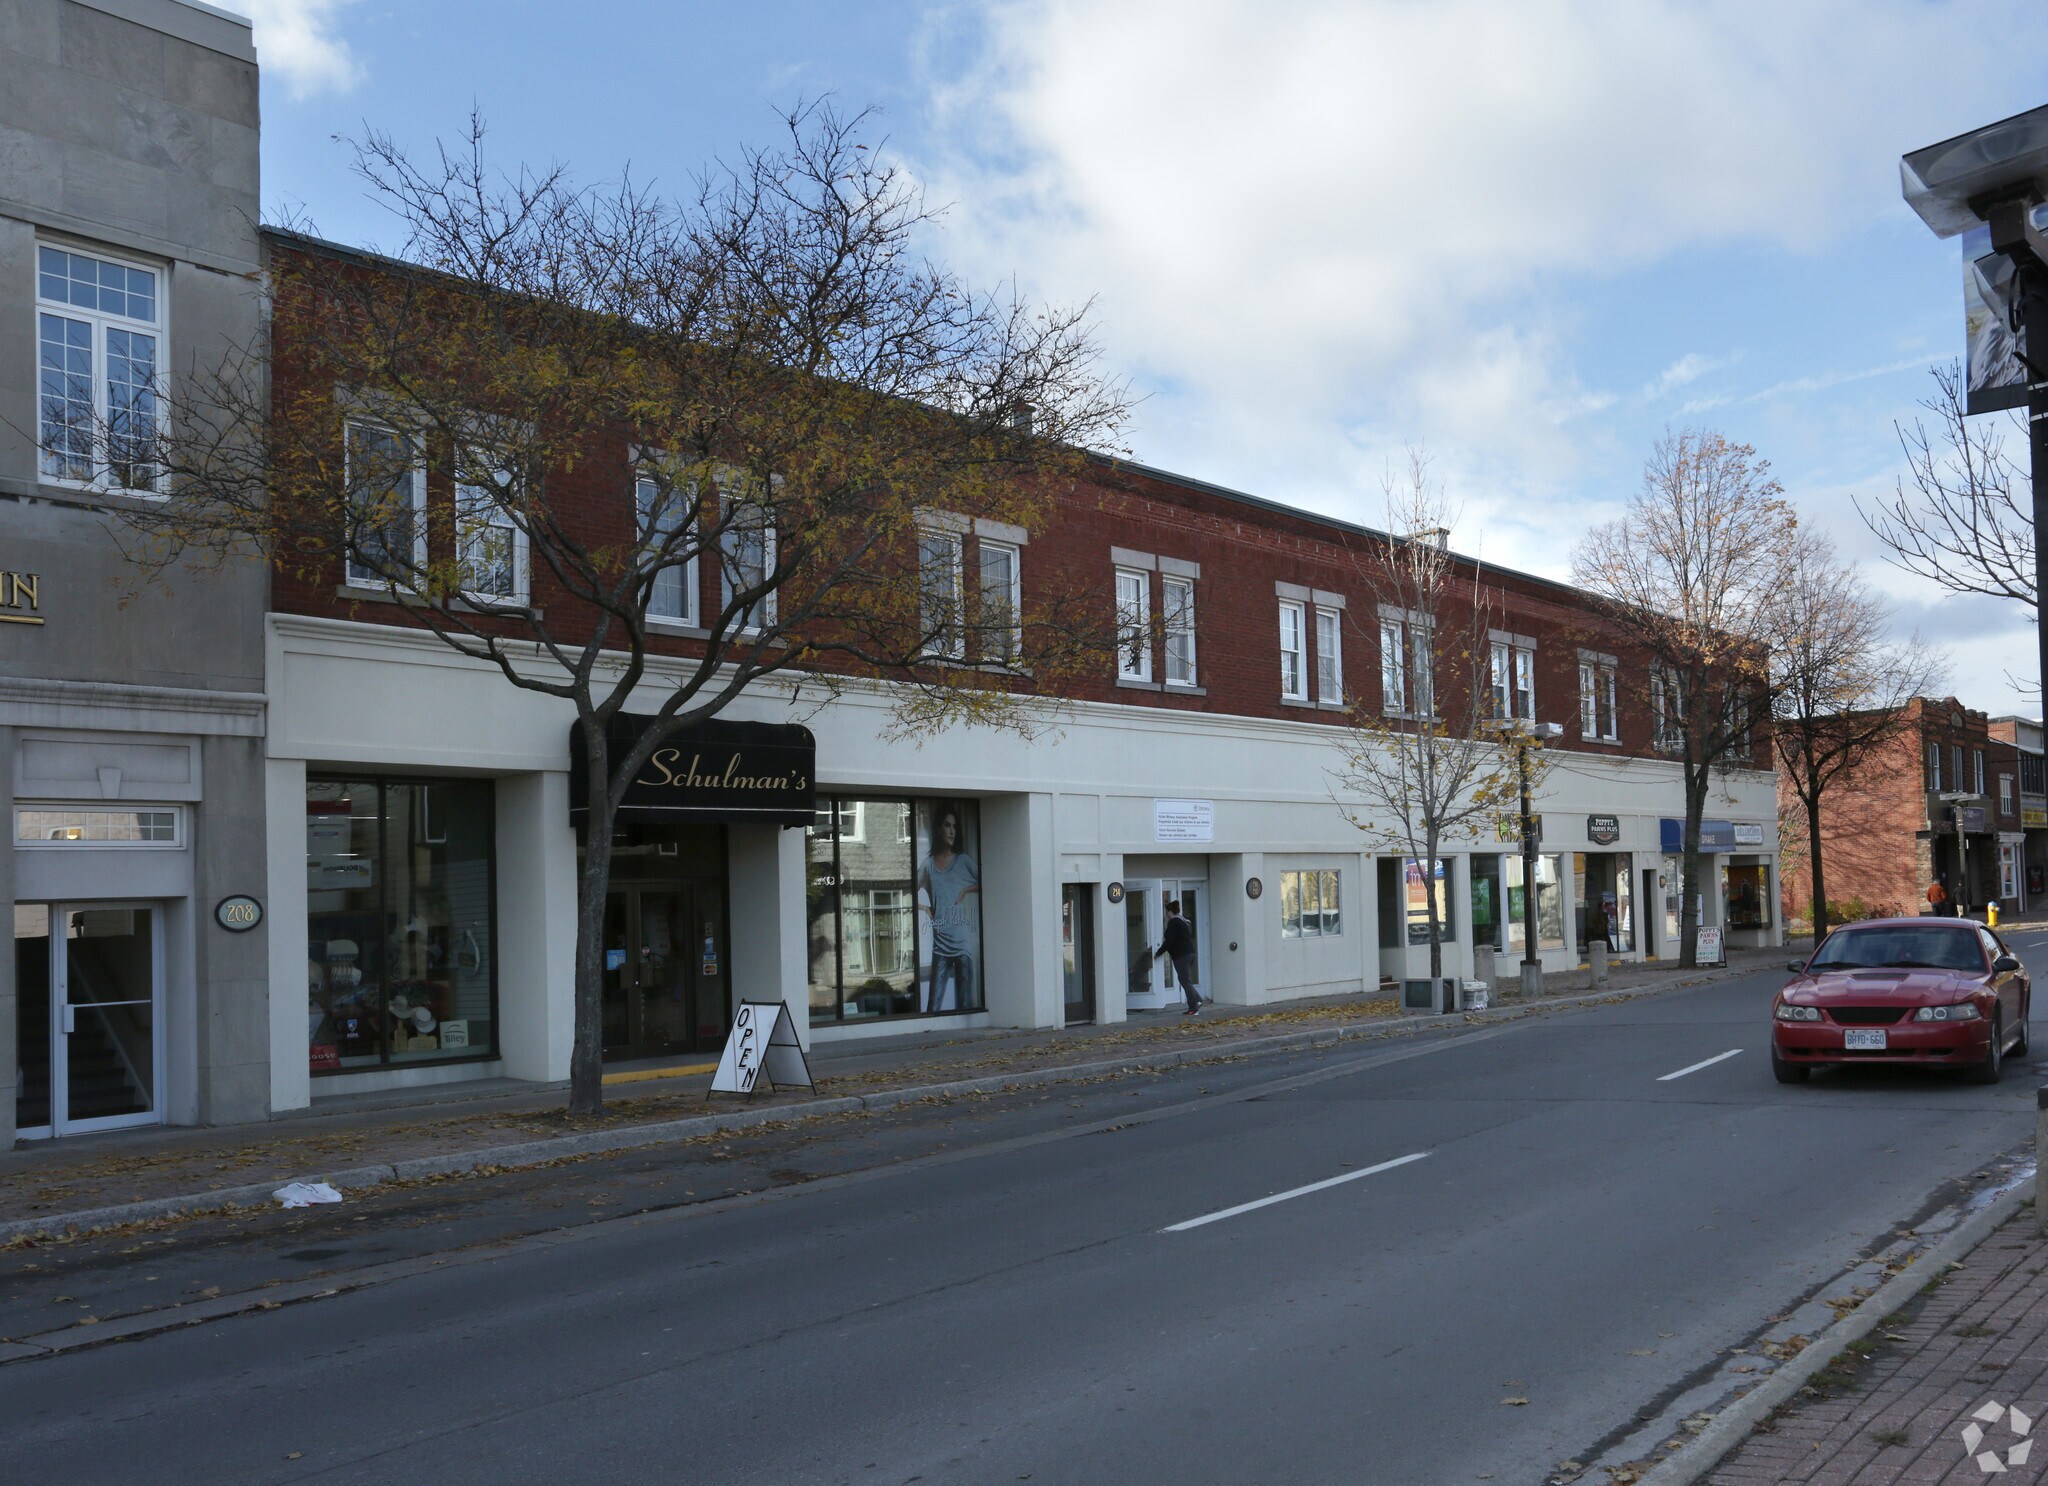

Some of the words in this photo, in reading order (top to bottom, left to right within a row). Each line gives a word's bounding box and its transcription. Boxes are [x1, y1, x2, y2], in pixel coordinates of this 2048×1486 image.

[636, 748, 807, 790] Schulman's
[226, 904, 254, 922] 208
[309, 1052, 336, 1060] oose
[737, 1007, 757, 1089] OPEN
